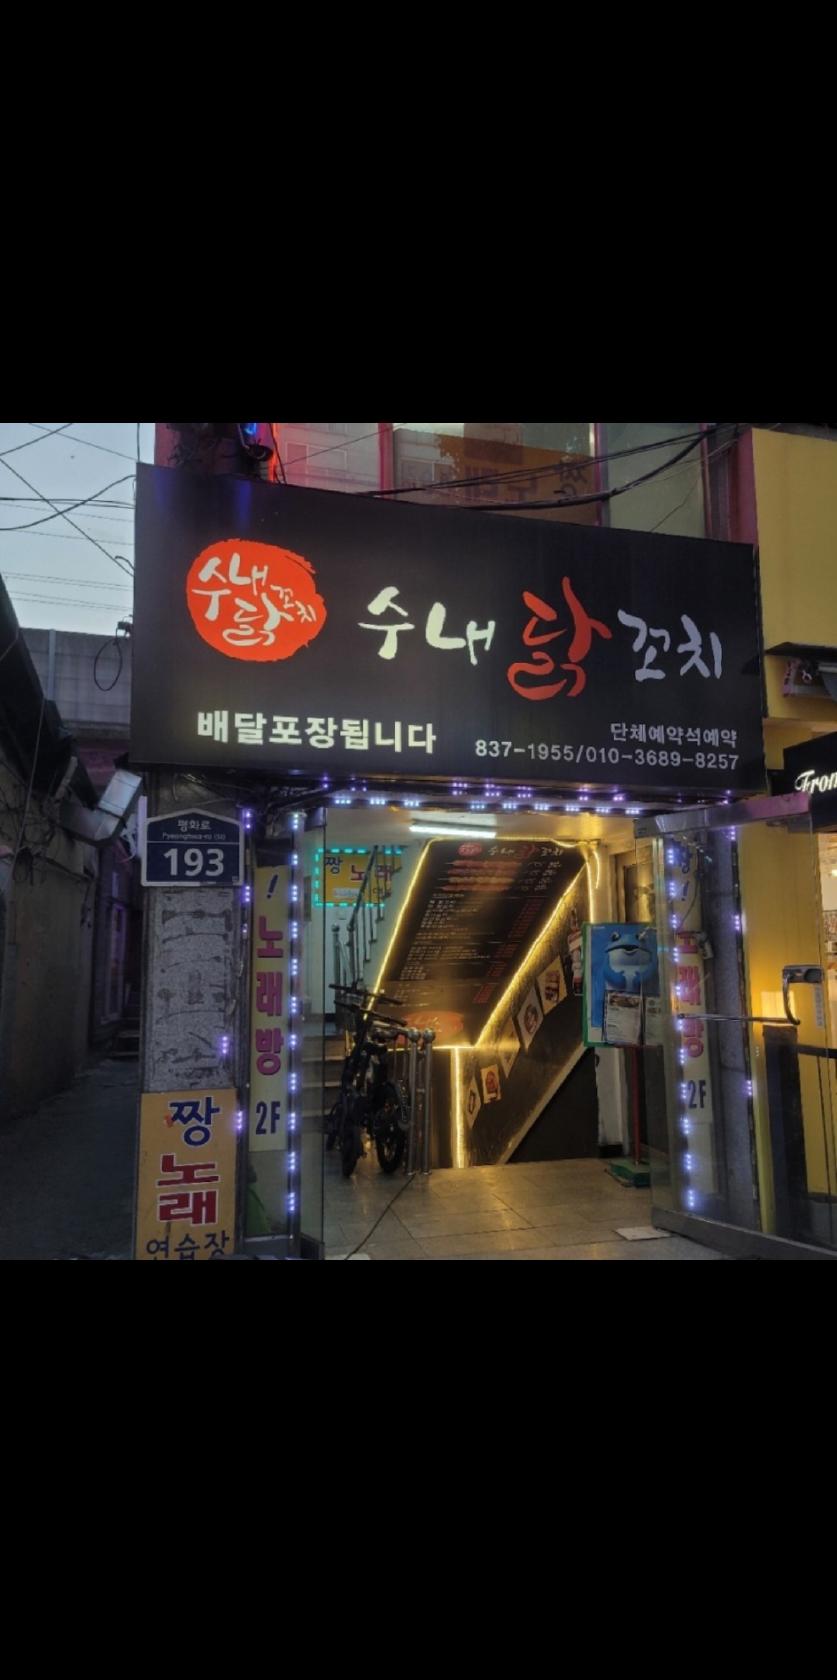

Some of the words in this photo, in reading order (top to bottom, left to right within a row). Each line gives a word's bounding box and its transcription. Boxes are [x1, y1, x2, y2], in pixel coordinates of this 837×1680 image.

[197, 710, 437, 754] 배달포장됩니다
[609, 722, 738, 748] 단체예약석예약
[474, 739, 740, 771] 837-1955/010-3689-8257
[177, 819, 211, 832] 평화로
[164, 848, 224, 877] 193
[256, 914, 284, 1076] 노래방
[687, 1080, 706, 1109] 2F
[169, 1096, 220, 1147] 짱
[255, 1100, 281, 1135] 2F
[157, 1154, 220, 1225] 노래
